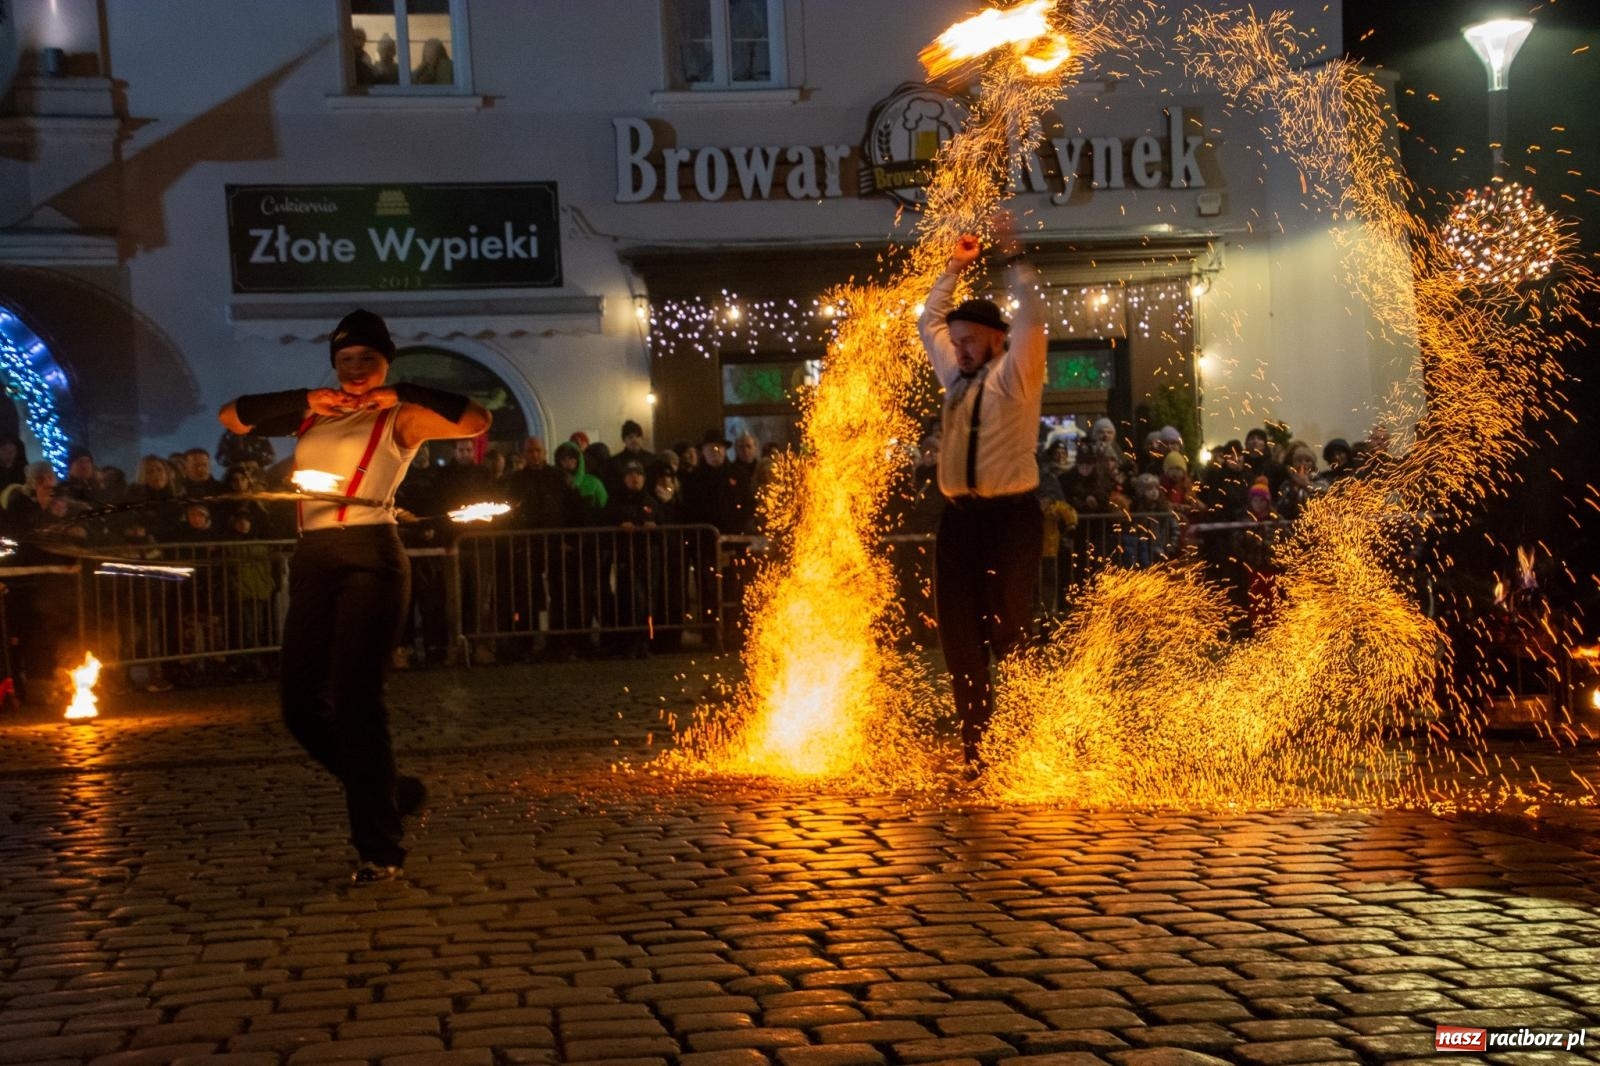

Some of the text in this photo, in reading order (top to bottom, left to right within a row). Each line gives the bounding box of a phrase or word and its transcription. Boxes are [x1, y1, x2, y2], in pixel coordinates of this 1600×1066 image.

[612, 117, 850, 204] Browar
[260, 194, 338, 216] Cukiernia
[249, 221, 539, 271] Złote Wypieki
